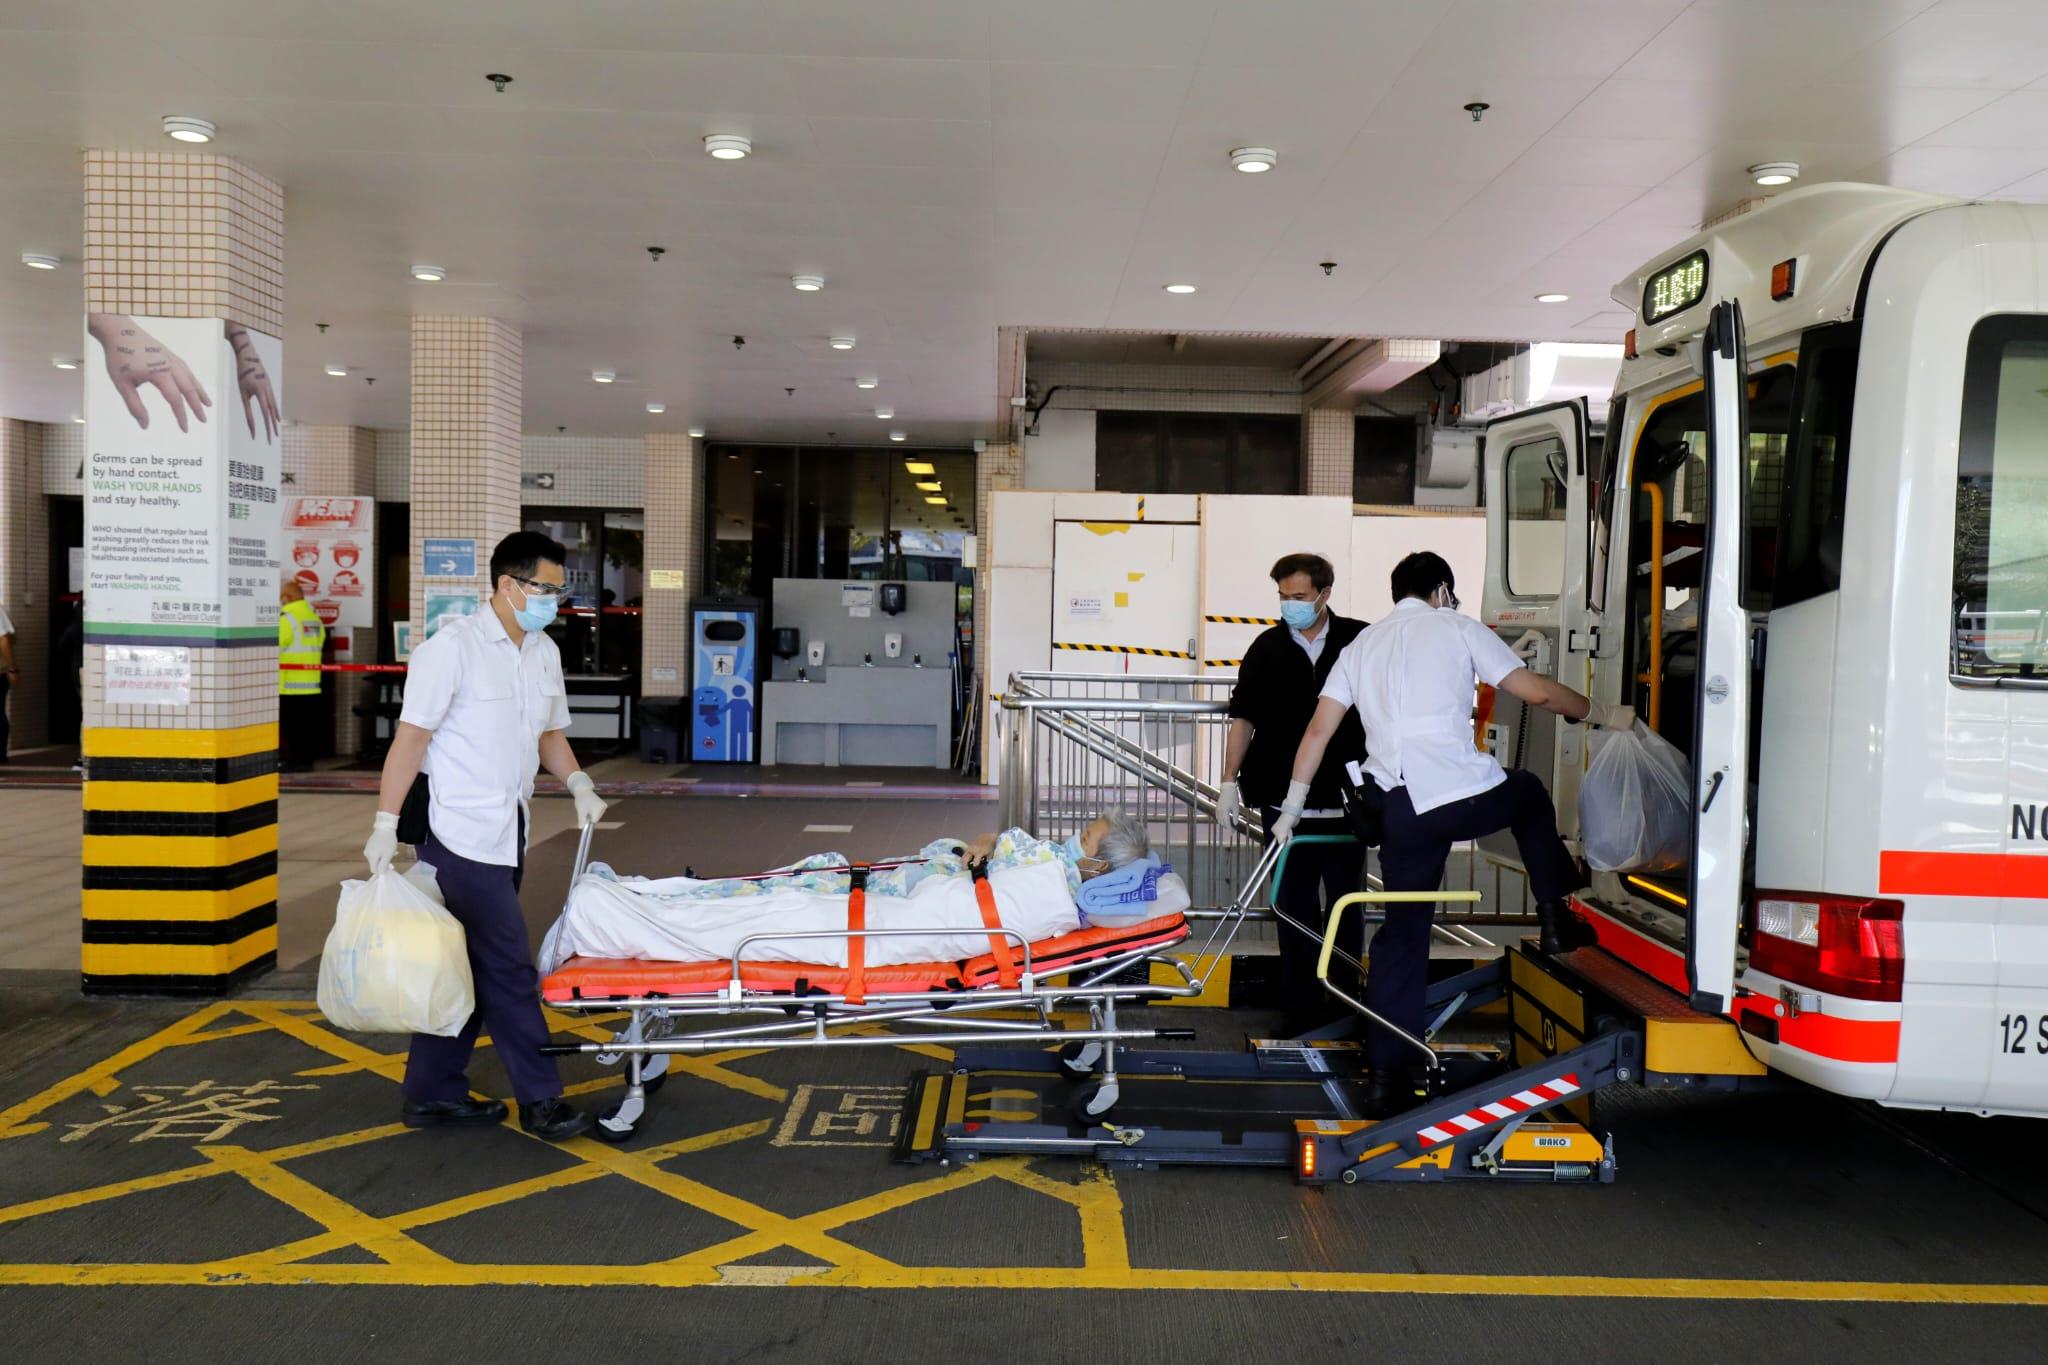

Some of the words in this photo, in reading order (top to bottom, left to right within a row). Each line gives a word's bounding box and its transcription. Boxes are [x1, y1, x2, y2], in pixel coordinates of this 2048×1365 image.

[92, 453, 127, 464] Germs
[129, 455, 148, 465] can
[151, 455, 164, 465] be
[167, 457, 203, 468] spread
[92, 466, 105, 479] by
[108, 467, 135, 478] hand
[138, 470, 181, 480] contact.
[92, 480, 126, 491] WASH
[128, 481, 160, 492] YOUR
[162, 483, 203, 494] HANDS
[92, 494, 112, 504] and
[115, 495, 137, 508] stay
[139, 495, 181, 509] healthy.
[92, 525, 112, 533] WHO
[114, 526, 142, 535] showed
[144, 527, 159, 535] that
[161, 528, 187, 537] regular
[189, 528, 208, 537] hand
[92, 536, 122, 545] washing
[124, 537, 149, 546] greatly
[151, 537, 180, 545] reduces
[182, 538, 195, 546] the
[195, 538, 209, 546] risk
[92, 544, 99, 552] of
[101, 545, 138, 554] spreading
[139, 546, 176, 554] infections
[177, 547, 194, 555] such
[91, 554, 130, 562] healthcare
[131, 555, 170, 563] associated
[91, 572, 103, 580] For
[104, 573, 122, 582] your
[124, 573, 147, 582] family
[149, 574, 164, 582] and
[91, 582, 108, 590] start
[110, 582, 149, 591] WASHING
[2000, 1013, 2028, 1054] 12
[59, 1080, 320, 1142] 落
[1539, 1138, 1567, 1146] WAKO
